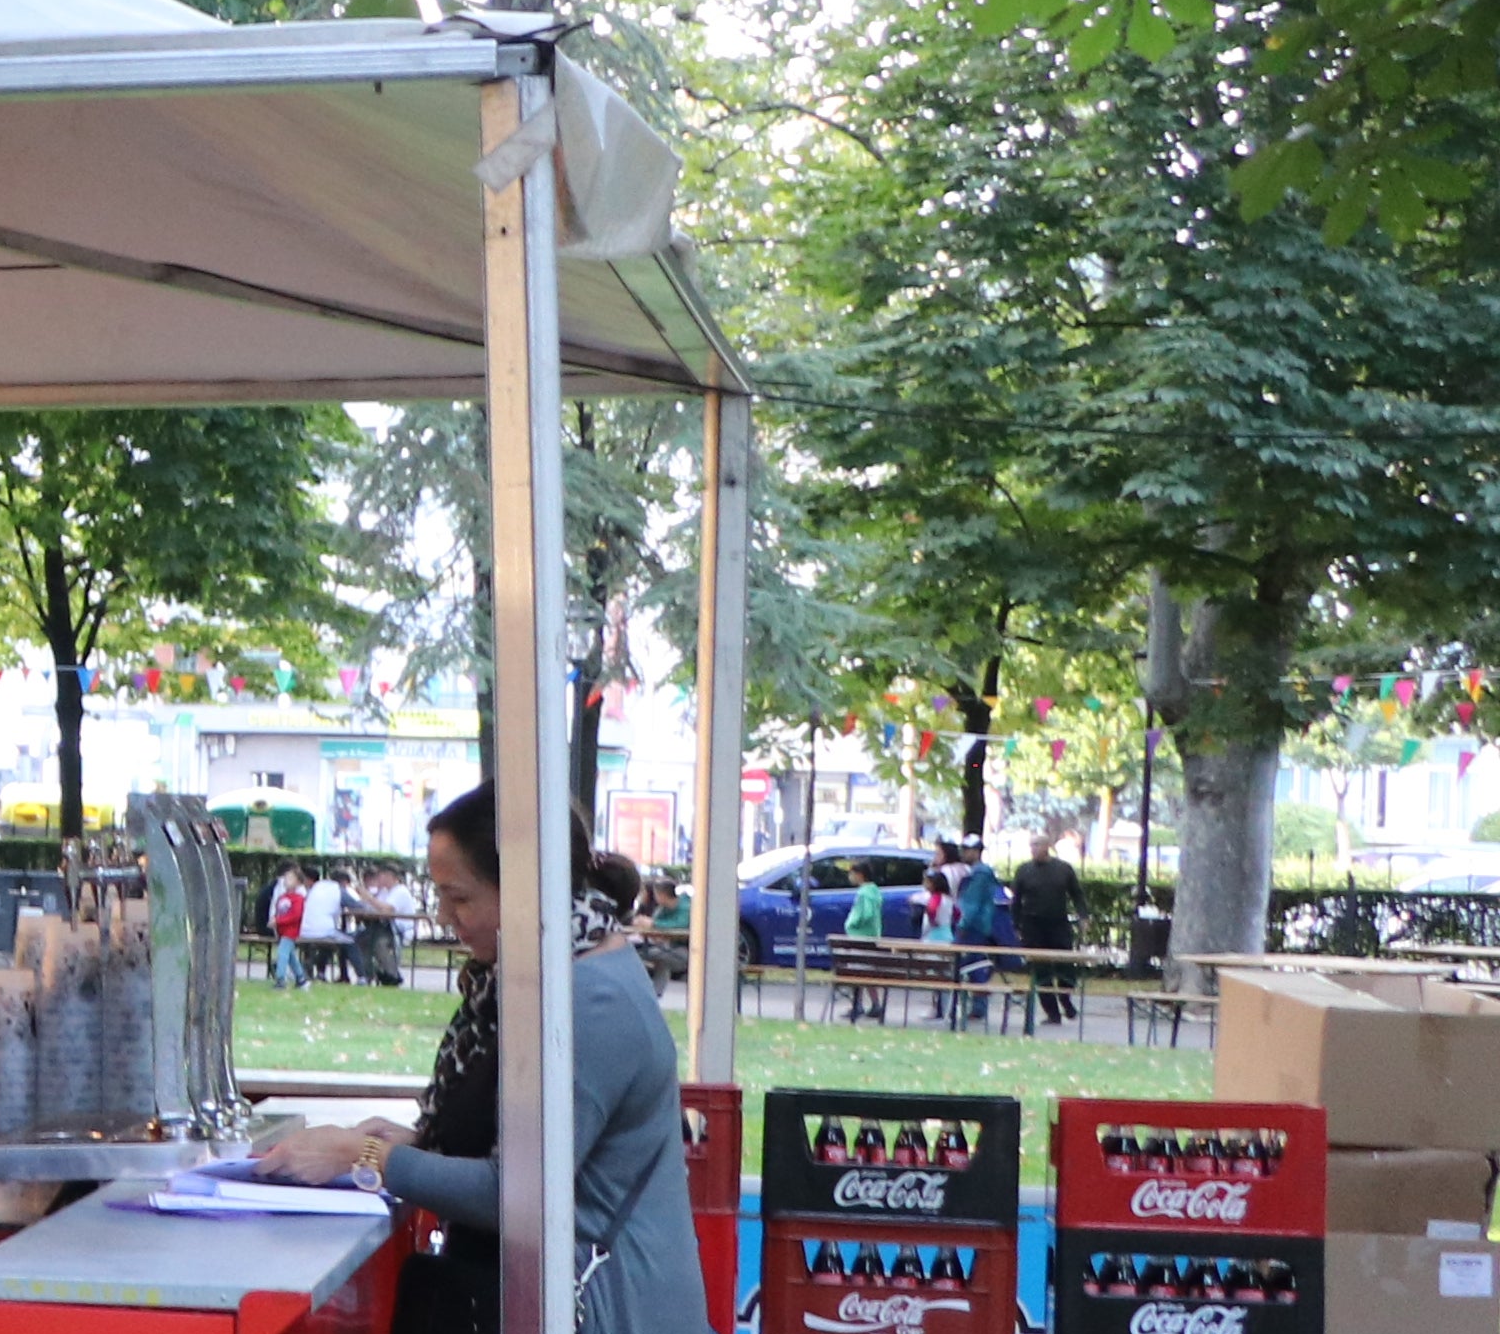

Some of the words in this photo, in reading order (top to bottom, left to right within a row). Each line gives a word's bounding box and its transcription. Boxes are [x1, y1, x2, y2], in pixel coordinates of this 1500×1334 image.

[833, 1169, 949, 1210] Coca-Cola
[1129, 1178, 1252, 1221] Coca-Cola
[838, 1291, 927, 1327] Coca-Cola
